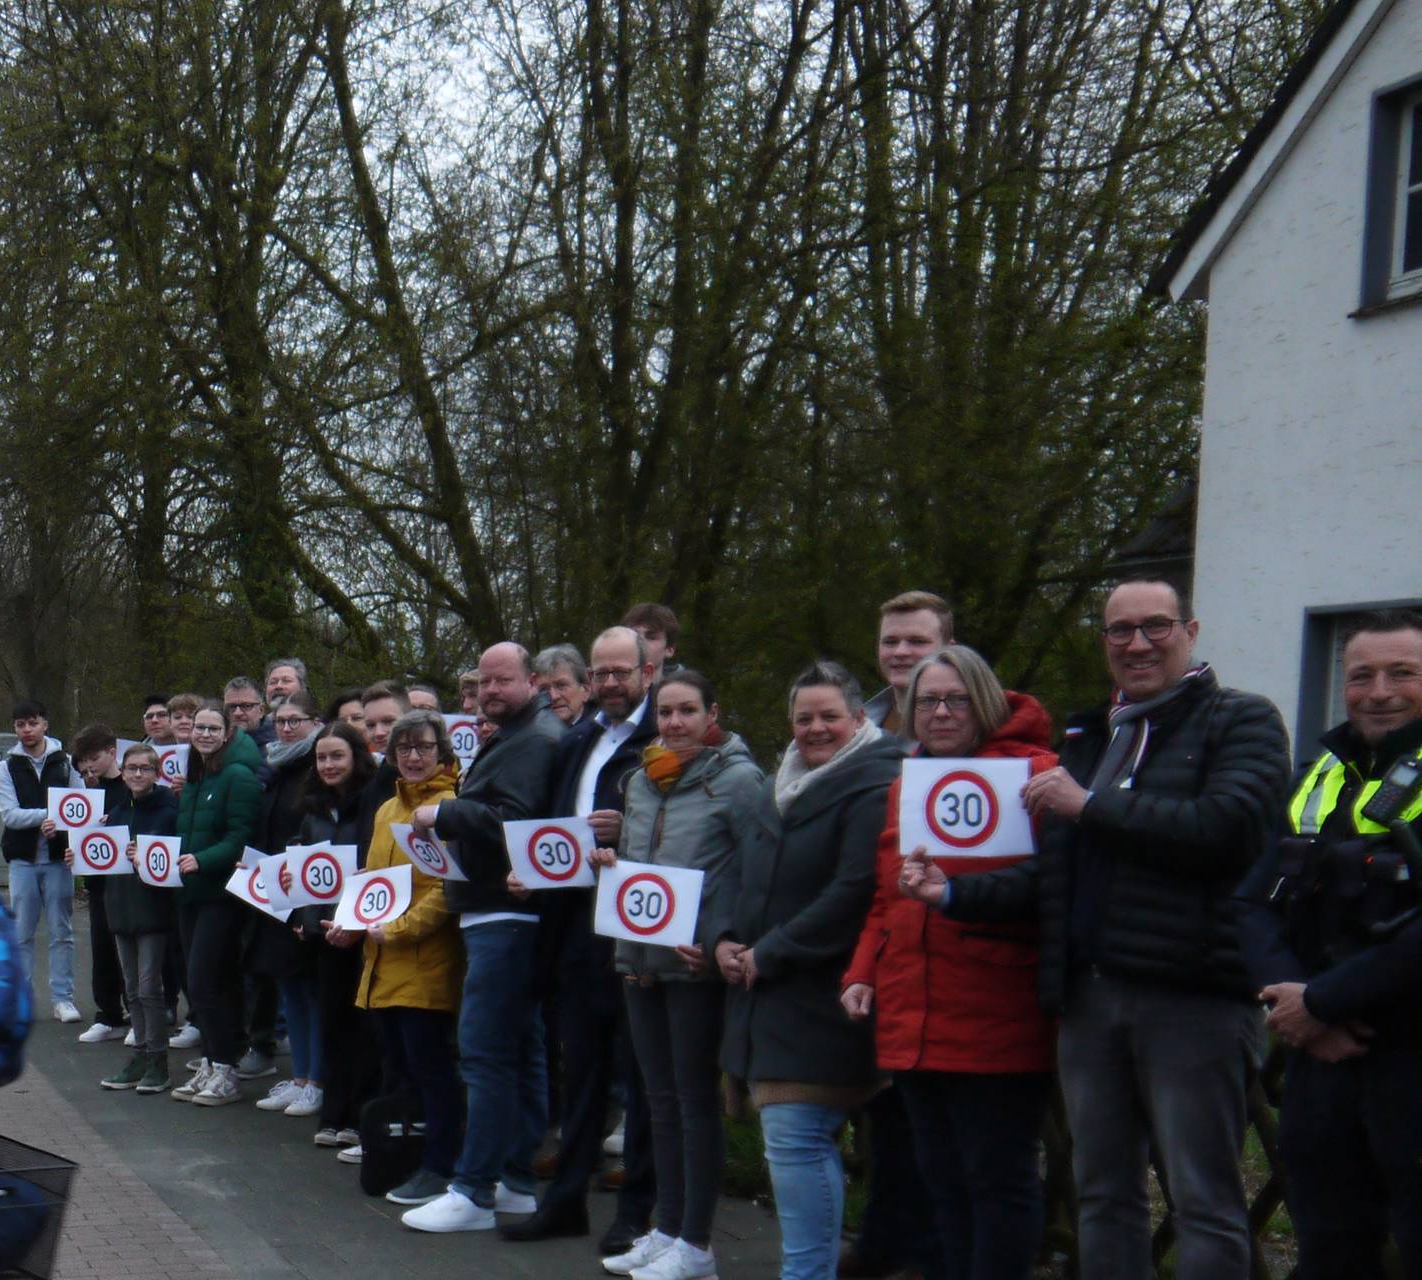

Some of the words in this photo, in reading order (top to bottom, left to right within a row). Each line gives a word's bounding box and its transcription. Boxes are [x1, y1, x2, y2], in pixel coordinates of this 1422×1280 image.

[454, 733, 474, 751] 30
[66, 803, 85, 819] 30
[941, 792, 982, 827] 30
[88, 843, 111, 861] 30
[151, 853, 166, 872] 30
[415, 843, 440, 864] 30
[538, 841, 571, 866] 30
[310, 866, 334, 888] 30
[363, 890, 387, 913] 30
[628, 889, 662, 919] 30
